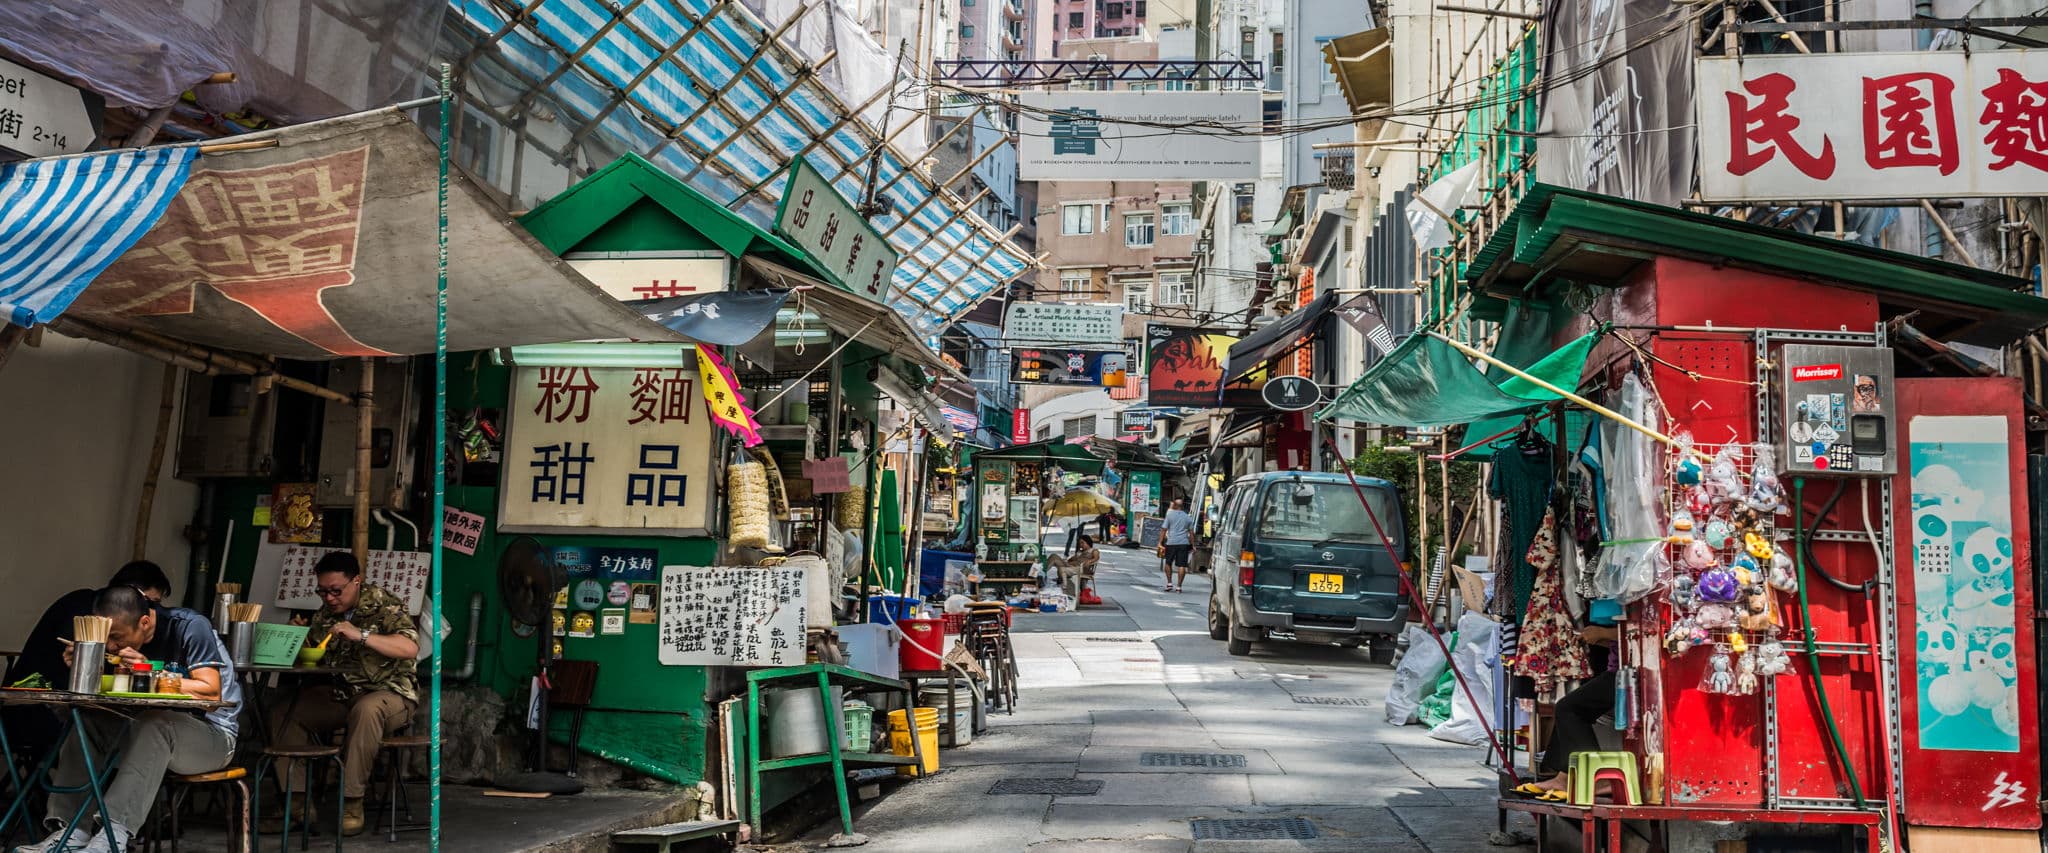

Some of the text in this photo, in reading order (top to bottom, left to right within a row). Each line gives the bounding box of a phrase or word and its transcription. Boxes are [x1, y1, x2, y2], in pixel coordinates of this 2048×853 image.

[0, 108, 24, 139] 街
[1159, 114, 1188, 122] pleasant
[1189, 114, 1216, 122] surprise
[1149, 326, 1172, 337] Carlsberg
[1796, 367, 1839, 378] Morrissey
[1124, 413, 1151, 427] Massage
[530, 442, 687, 507] 甜品
[600, 555, 654, 574] 全力支持
[1319, 573, 1334, 584] JL
[1312, 582, 1341, 593] 3692
